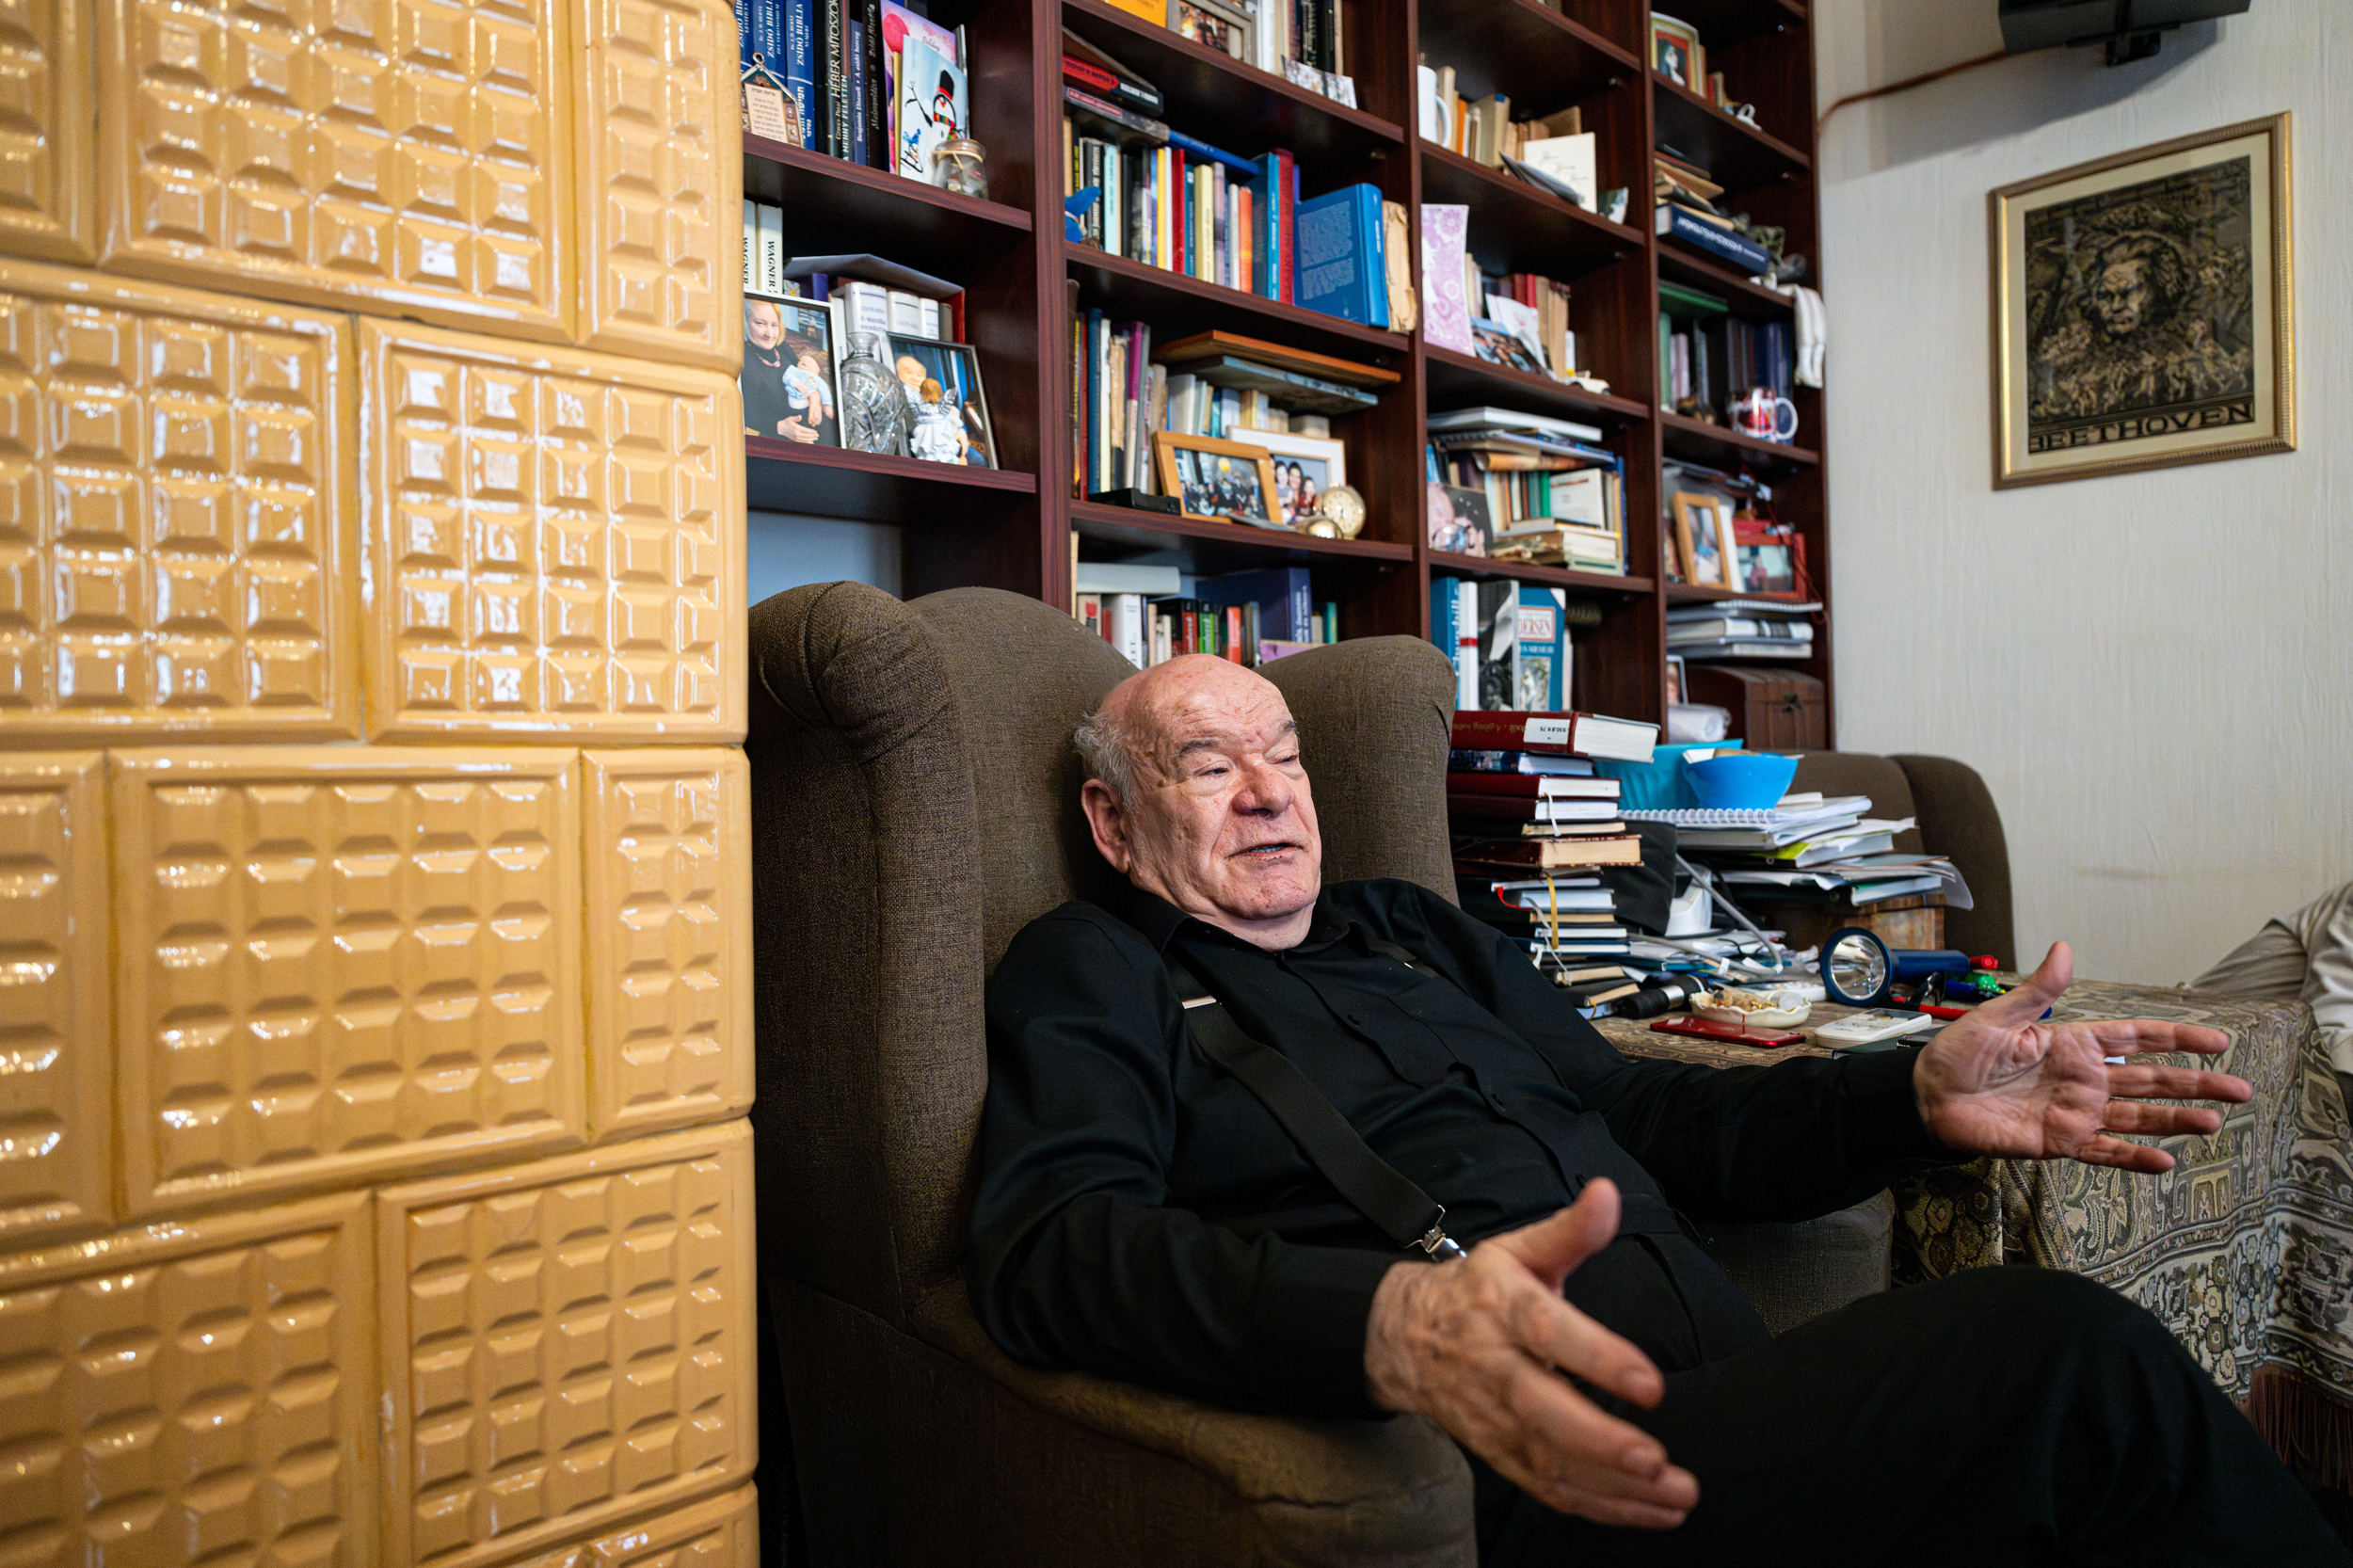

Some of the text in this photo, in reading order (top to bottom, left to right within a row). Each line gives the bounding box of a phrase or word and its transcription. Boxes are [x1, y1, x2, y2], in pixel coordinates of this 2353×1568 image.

[765, 28, 775, 58] ZSIDÓ
[794, 3, 805, 66] ZSIDÓ BIBLIA
[828, 59, 841, 99] HÉBER
[766, 240, 776, 288] WAGNER
[2028, 403, 2253, 453] BEETHOVEN
